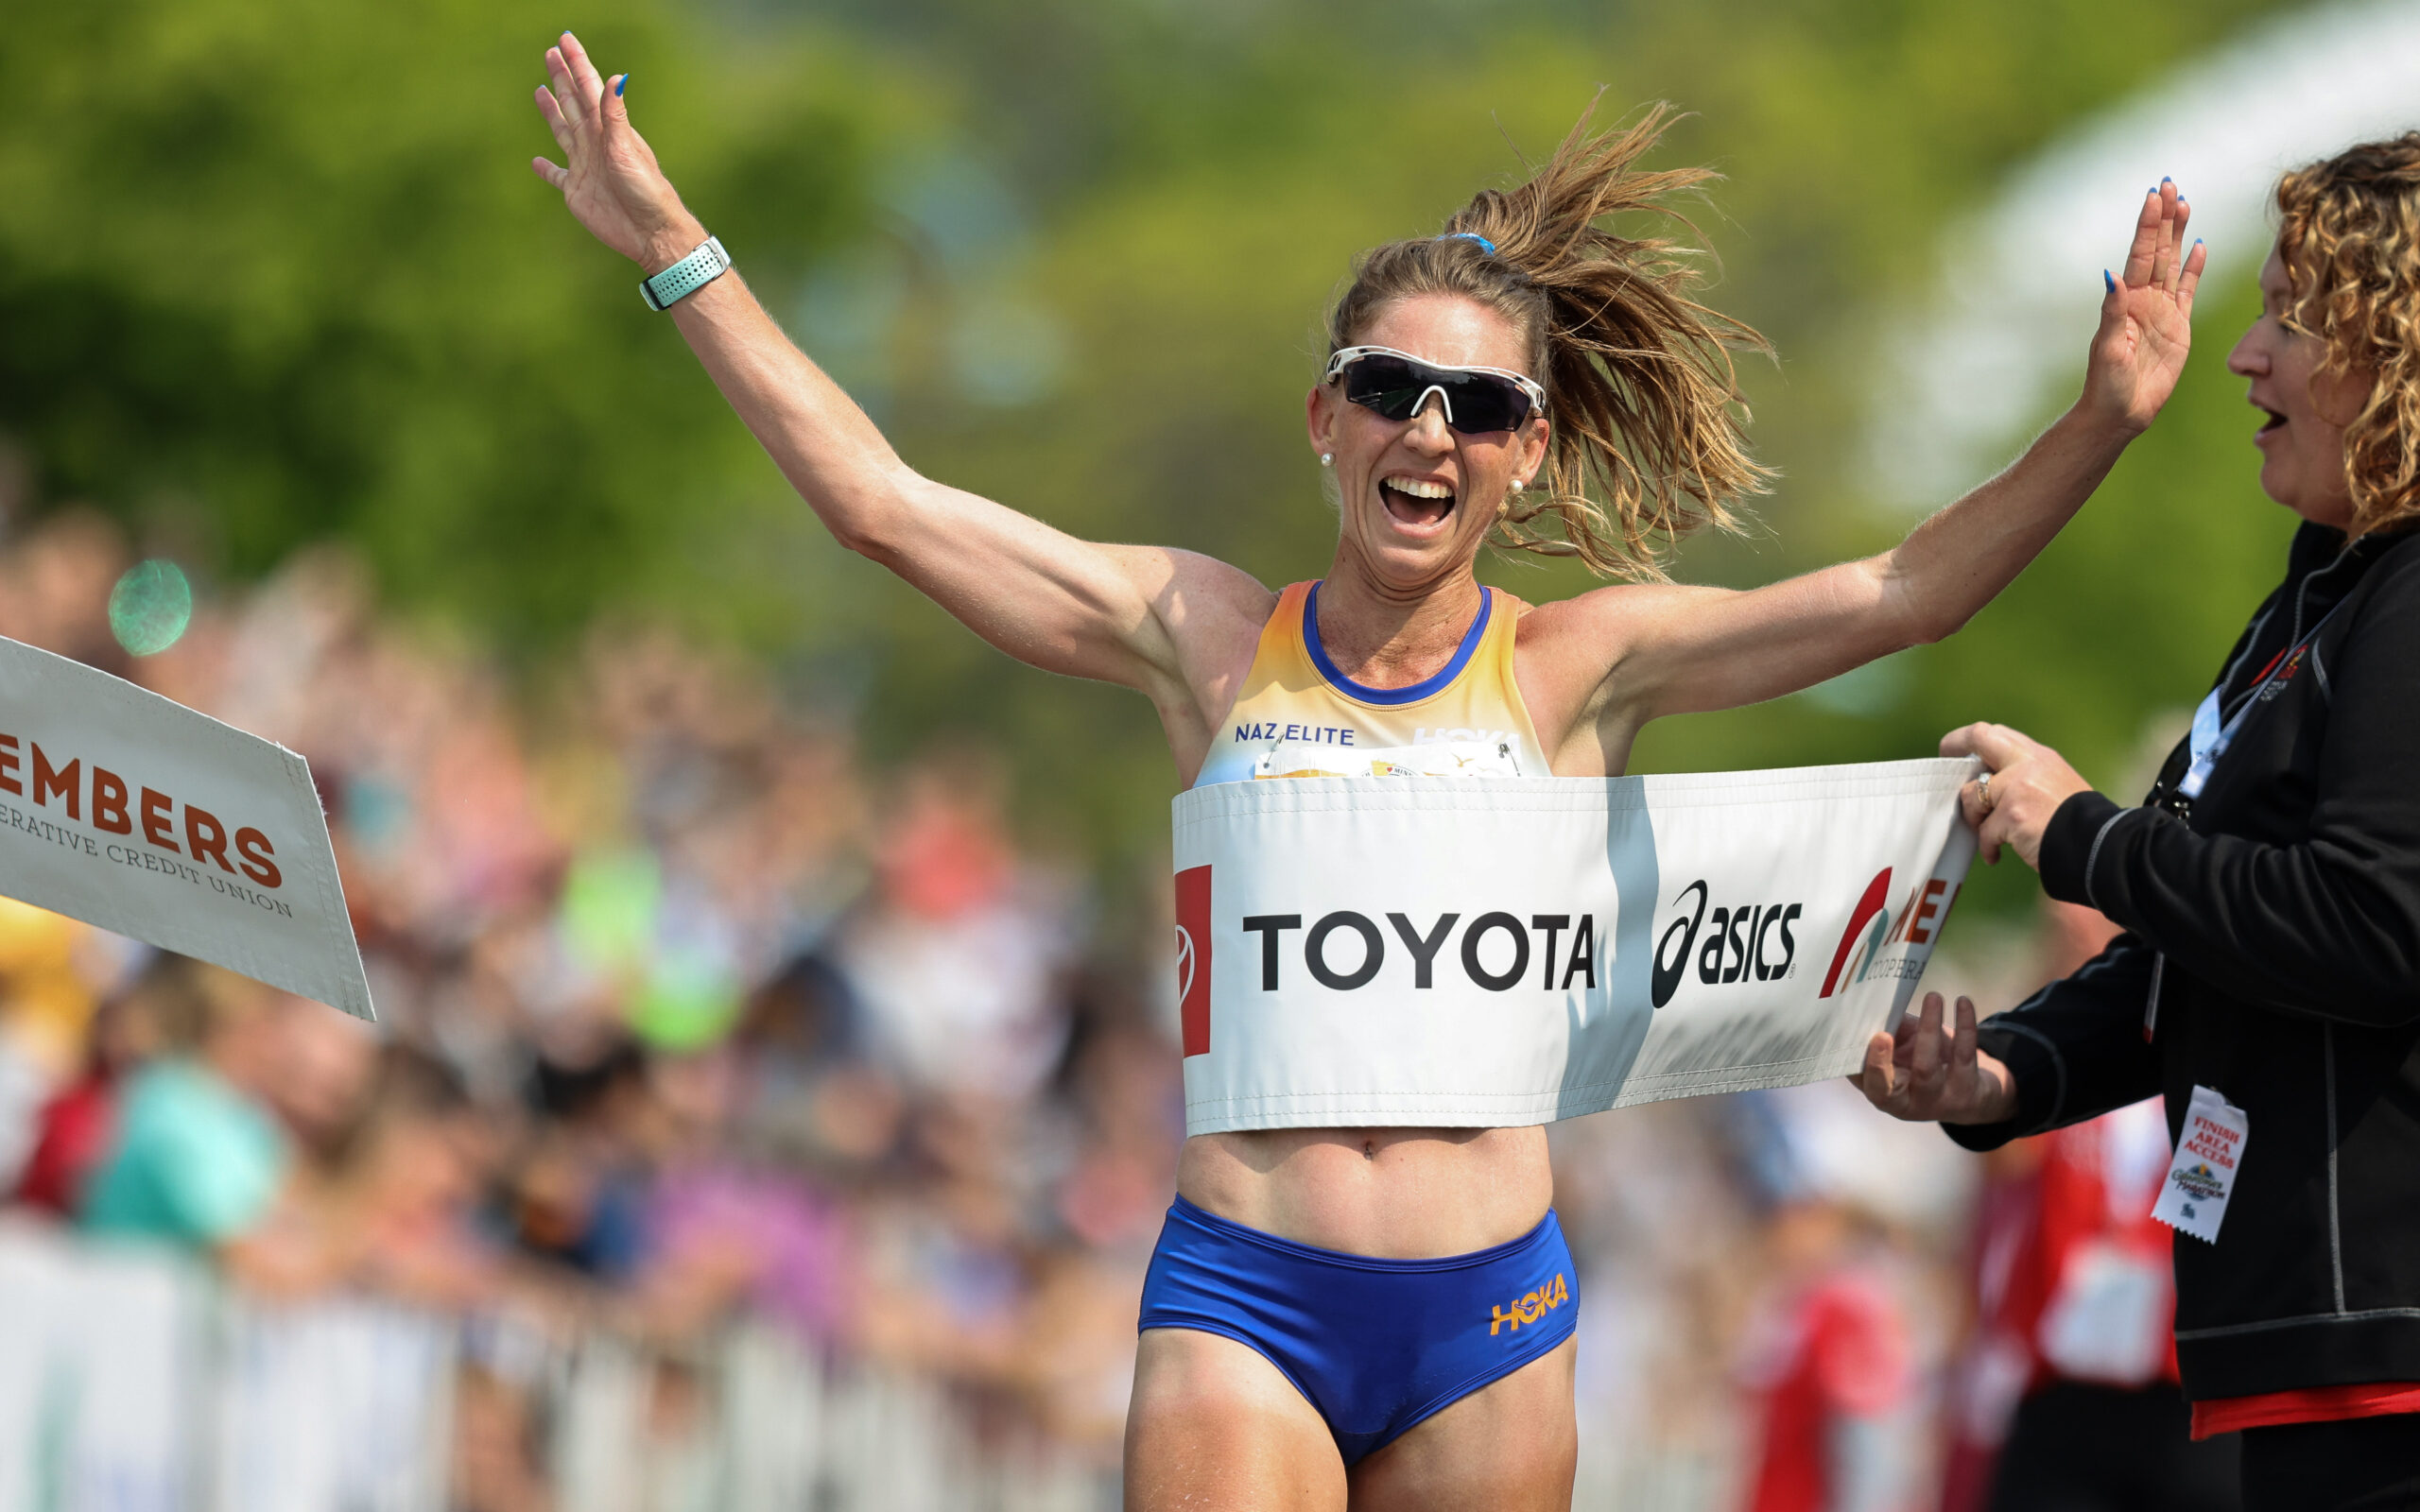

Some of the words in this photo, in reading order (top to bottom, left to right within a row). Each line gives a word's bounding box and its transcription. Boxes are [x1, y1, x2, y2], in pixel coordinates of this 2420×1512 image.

[1235, 722, 1278, 743] NAZ
[1285, 724, 1355, 747] ELITE
[0, 732, 283, 888] EMBERS
[0, 802, 98, 857] ERATIVE
[106, 844, 201, 885] CREDIT
[206, 874, 293, 919] UNION
[1882, 878, 1962, 947] ME
[1242, 909, 1597, 992] TOYOTA
[2184, 1141, 2235, 1170] ACCESS
[2194, 1116, 2239, 1143] FINISH
[2196, 1131, 2229, 1154] AREA
[1490, 1272, 1569, 1336] HOKA
